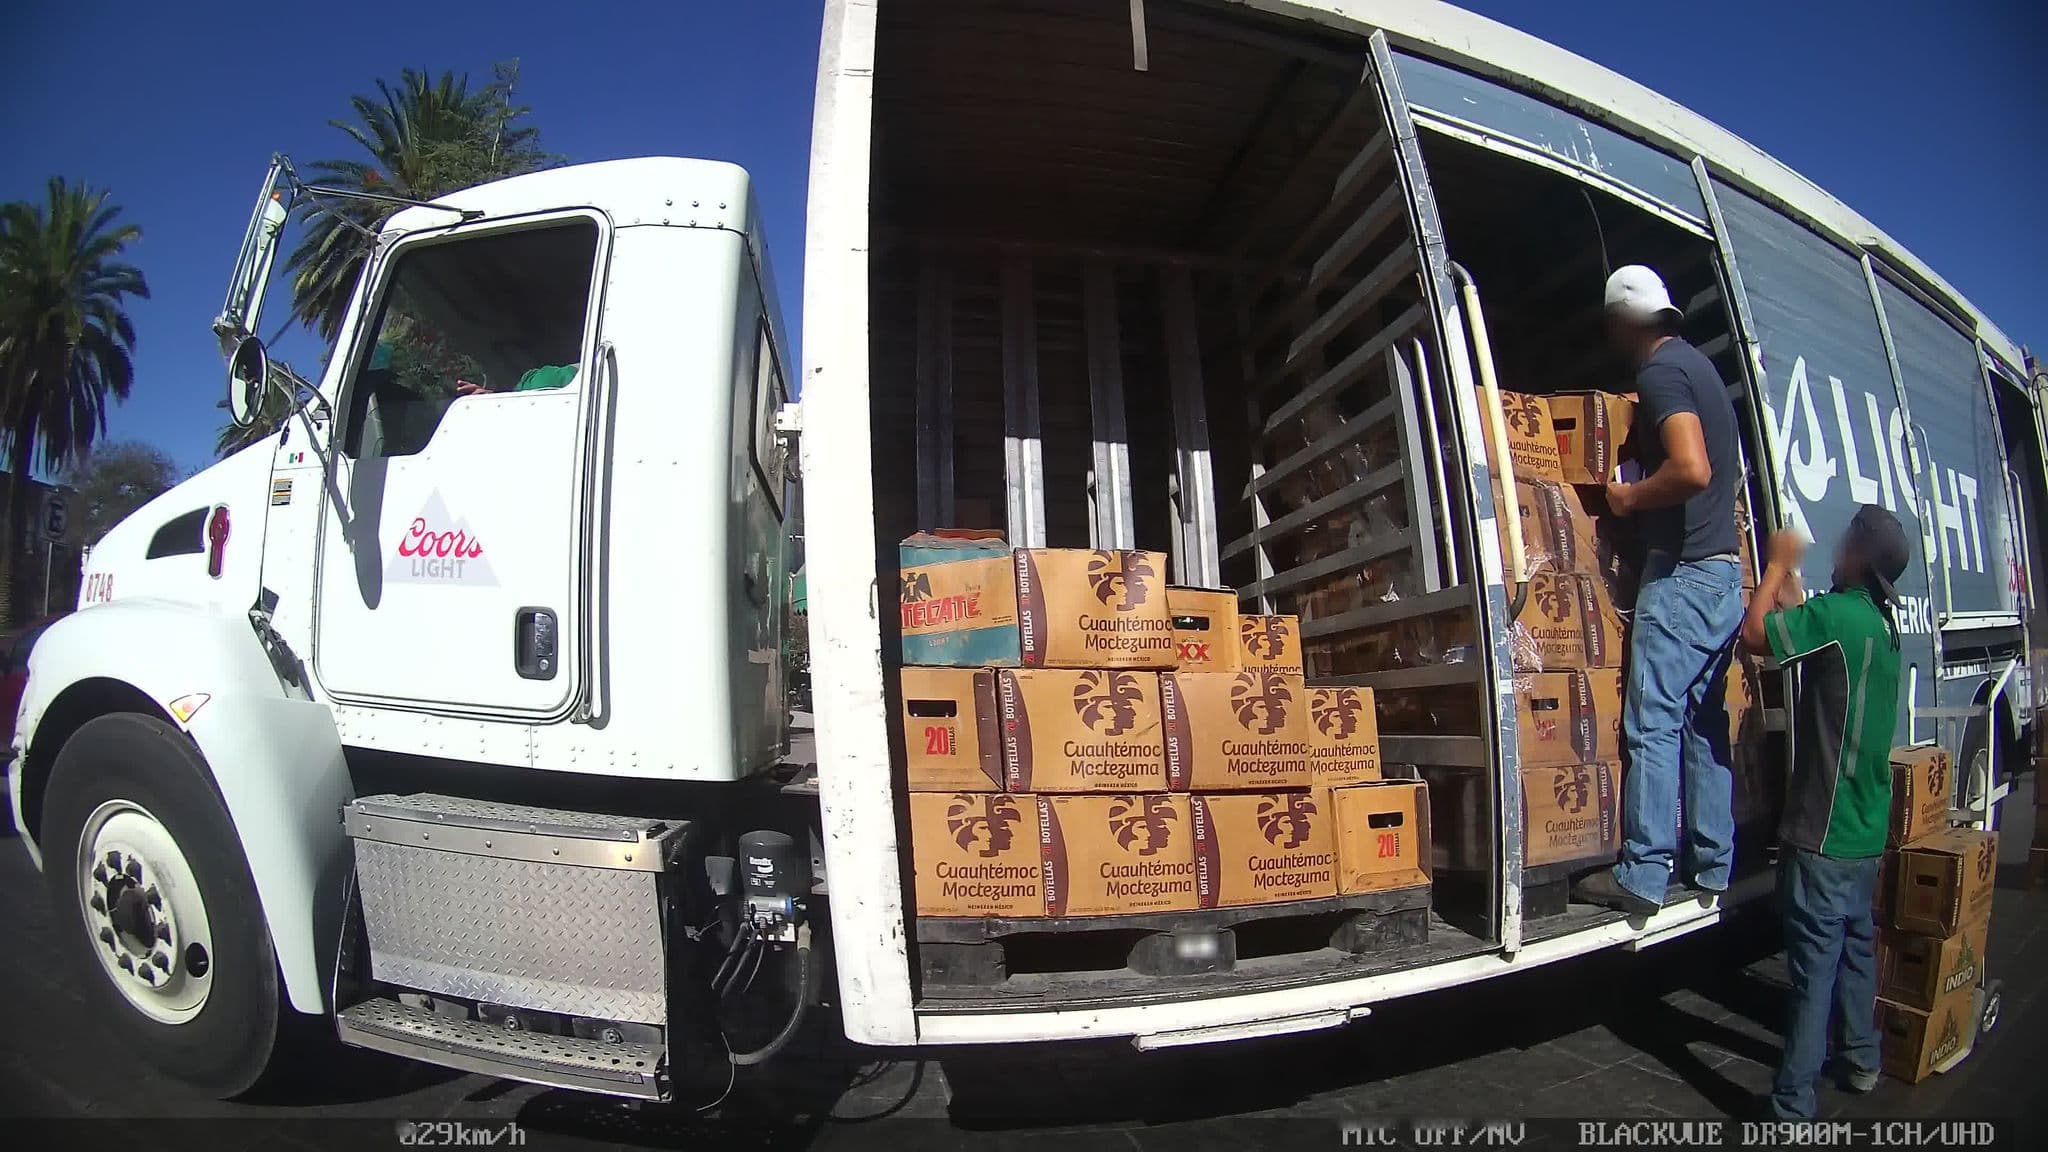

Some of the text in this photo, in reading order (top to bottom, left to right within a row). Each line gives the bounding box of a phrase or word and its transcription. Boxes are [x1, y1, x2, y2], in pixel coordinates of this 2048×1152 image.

[398, 517, 483, 558] Coors
[411, 558, 466, 578] LIGHT
[1018, 553, 1029, 593] BOTELLAS
[901, 590, 982, 628] TECATE
[1023, 610, 1034, 651] BOTELLAS
[1079, 614, 1172, 632] Cuauhtémoc
[1085, 634, 1171, 653] Moctezuma
[1003, 677, 1014, 719] BOTELLAS
[1164, 680, 1176, 720] BOTELLAS
[925, 726, 949, 755] 20
[1064, 740, 1161, 758] Cuauhtémoc
[1222, 740, 1308, 757] Cuauhtémoc
[1008, 736, 1019, 779] BOTELLAS
[1070, 760, 1159, 779] Moctezuma
[1169, 737, 1180, 777] BOTELLAS
[1228, 758, 1305, 776] Moctezuma
[1310, 758, 1375, 775] Moctezuma
[1038, 801, 1050, 843] BOTELLAS
[1194, 800, 1205, 840] BOTELLAS
[1378, 834, 1394, 858] 20
[936, 861, 1039, 880] Cuauhtémoc
[1099, 859, 1194, 879] Cuauhtémoc
[1199, 856, 1209, 895] BOTELLAS
[1248, 853, 1332, 872] Cuauhtémoc
[942, 881, 1036, 901] Moctezuma
[1045, 860, 1056, 901] BOTELLAS
[1106, 879, 1192, 899] Moctezuma
[1254, 870, 1330, 890] Moctezuma
[1945, 965, 1975, 993] INDIO
[1930, 1036, 1957, 1065] INDIO
